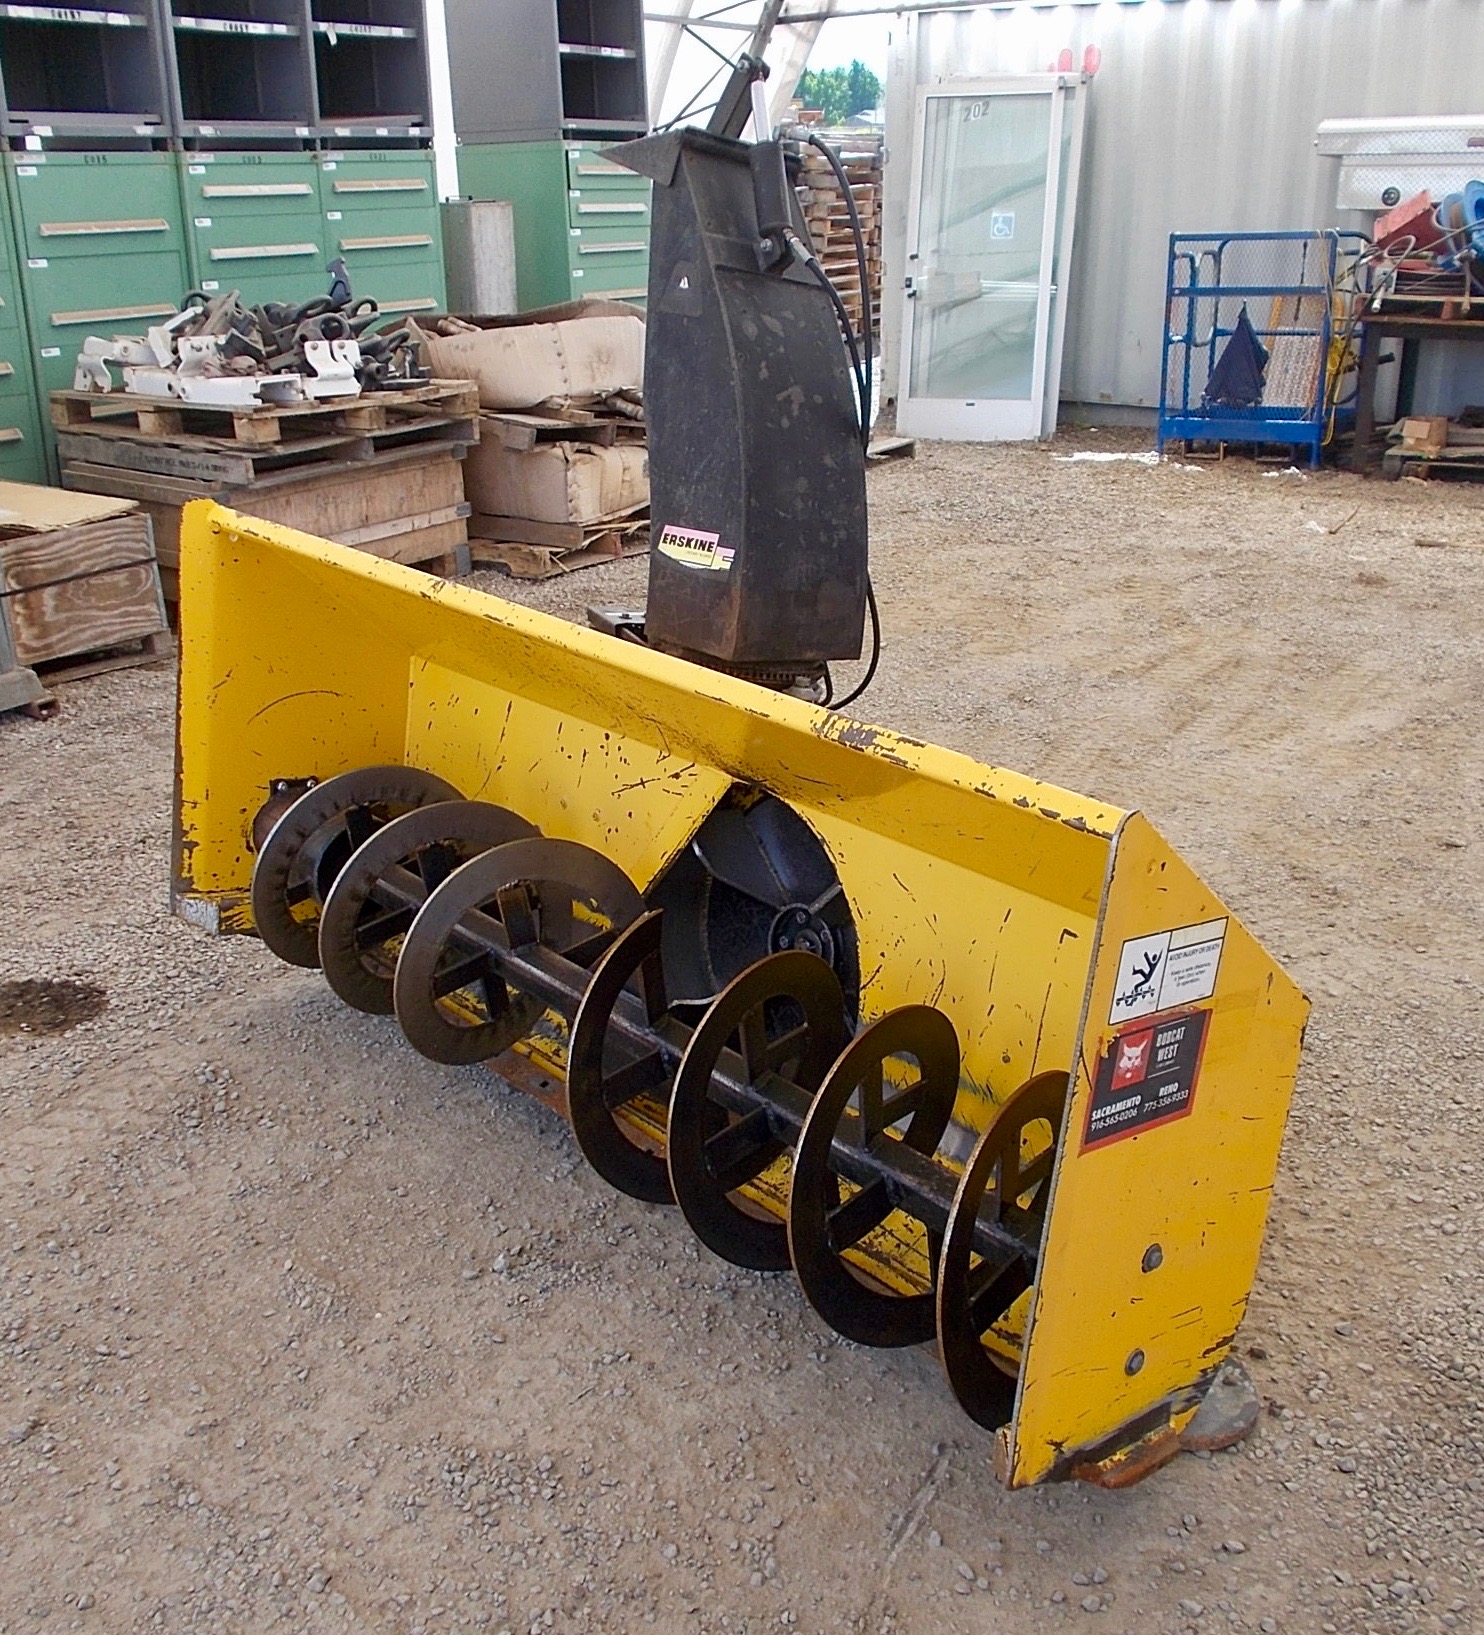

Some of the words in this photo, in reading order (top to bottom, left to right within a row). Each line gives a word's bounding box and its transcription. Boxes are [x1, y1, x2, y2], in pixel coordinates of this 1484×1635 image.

[963, 100, 990, 123] 202
[661, 532, 715, 553] ERSKINE
[1156, 1026, 1186, 1048] BOBCAT
[1157, 1043, 1179, 1062] WEST
[1158, 1082, 1179, 1097] RENO
[1091, 1094, 1142, 1121] SACRAMENTO
[1091, 1107, 1138, 1132] 916-565-0206
